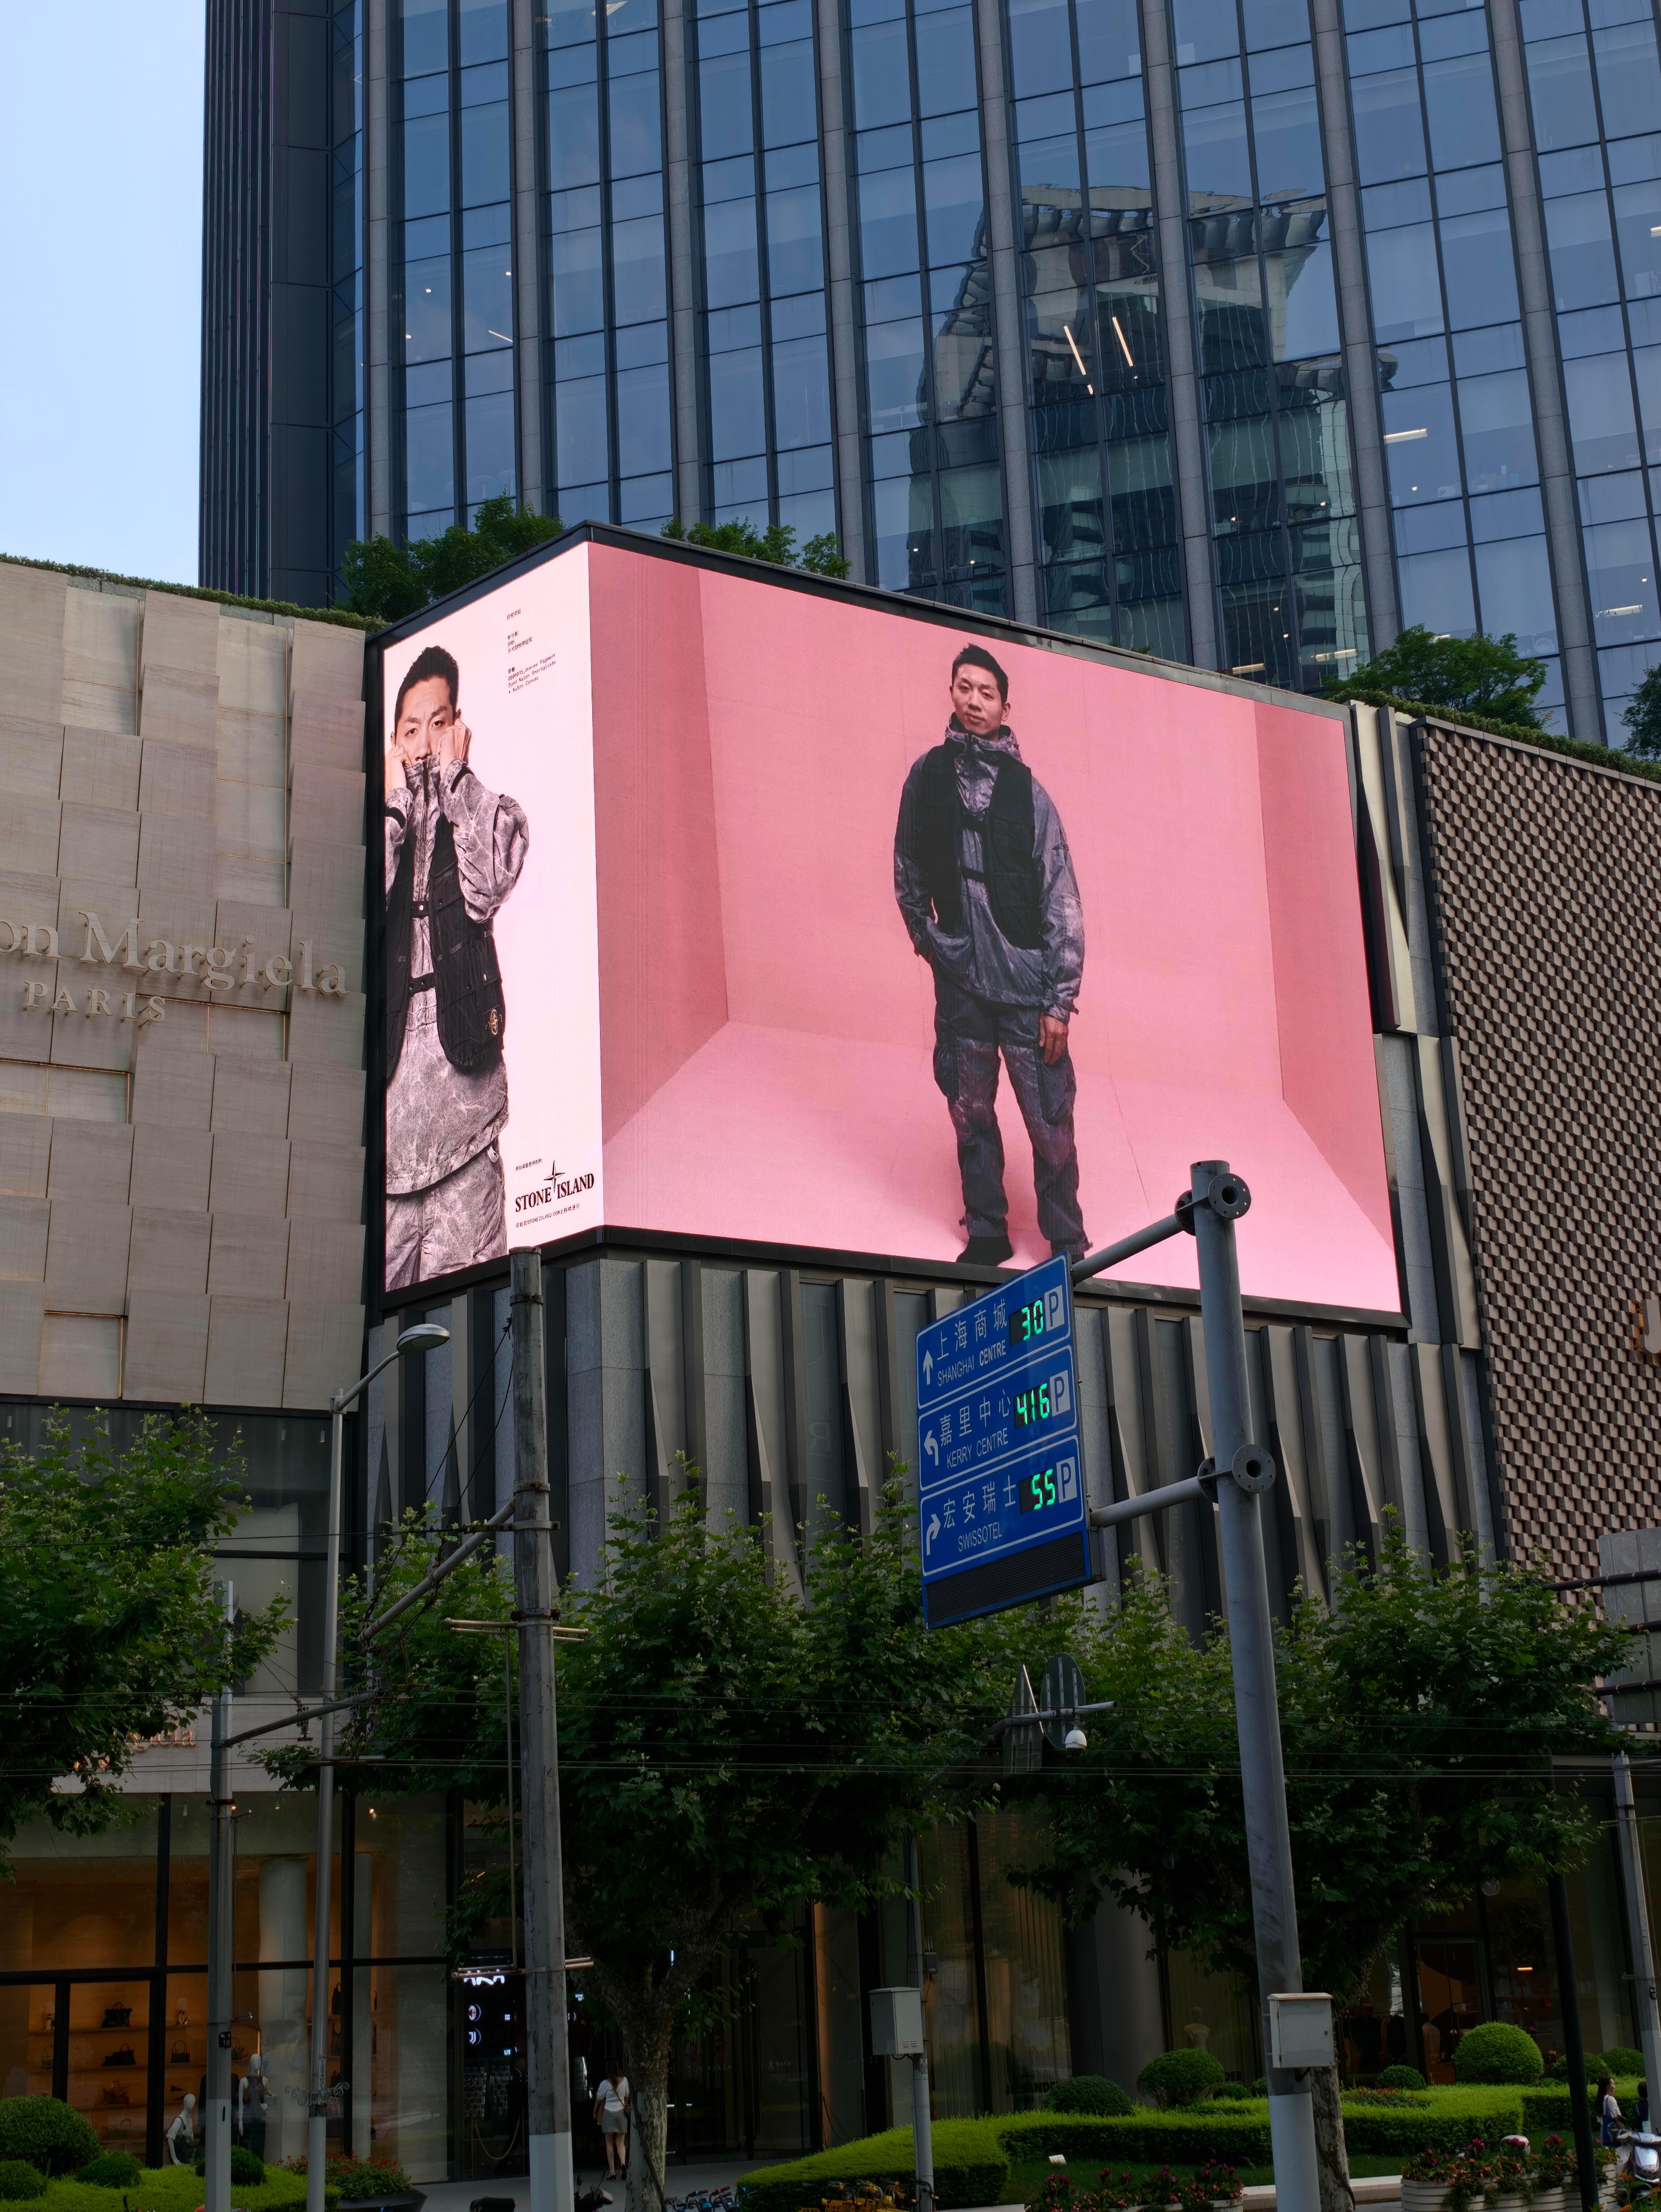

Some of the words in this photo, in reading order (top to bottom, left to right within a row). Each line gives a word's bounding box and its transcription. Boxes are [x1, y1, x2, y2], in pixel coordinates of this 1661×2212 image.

[78, 911, 350, 996] Margiela
[24, 980, 166, 1023] PARIS
[515, 1187, 551, 1212] STONE
[557, 1173, 595, 1199] ISLAND
[937, 1299, 1007, 1361] 上海商城
[1021, 1300, 1043, 1341] 30
[1049, 1291, 1059, 1327] P
[937, 1356, 974, 1387] SHANGHAI
[979, 1339, 1006, 1366] CENTRE
[940, 1389, 1011, 1447] 嘉里中心
[1017, 1383, 1050, 1425] 416
[1054, 1376, 1065, 1412] P
[947, 1443, 972, 1469] KERRY
[977, 1427, 1008, 1457] CENTRE
[943, 1475, 1016, 1529] 宏安瑞士
[1030, 1469, 1056, 1510] 55
[1061, 1462, 1072, 1500] P
[958, 1521, 1003, 1552] SWISSOTEL
